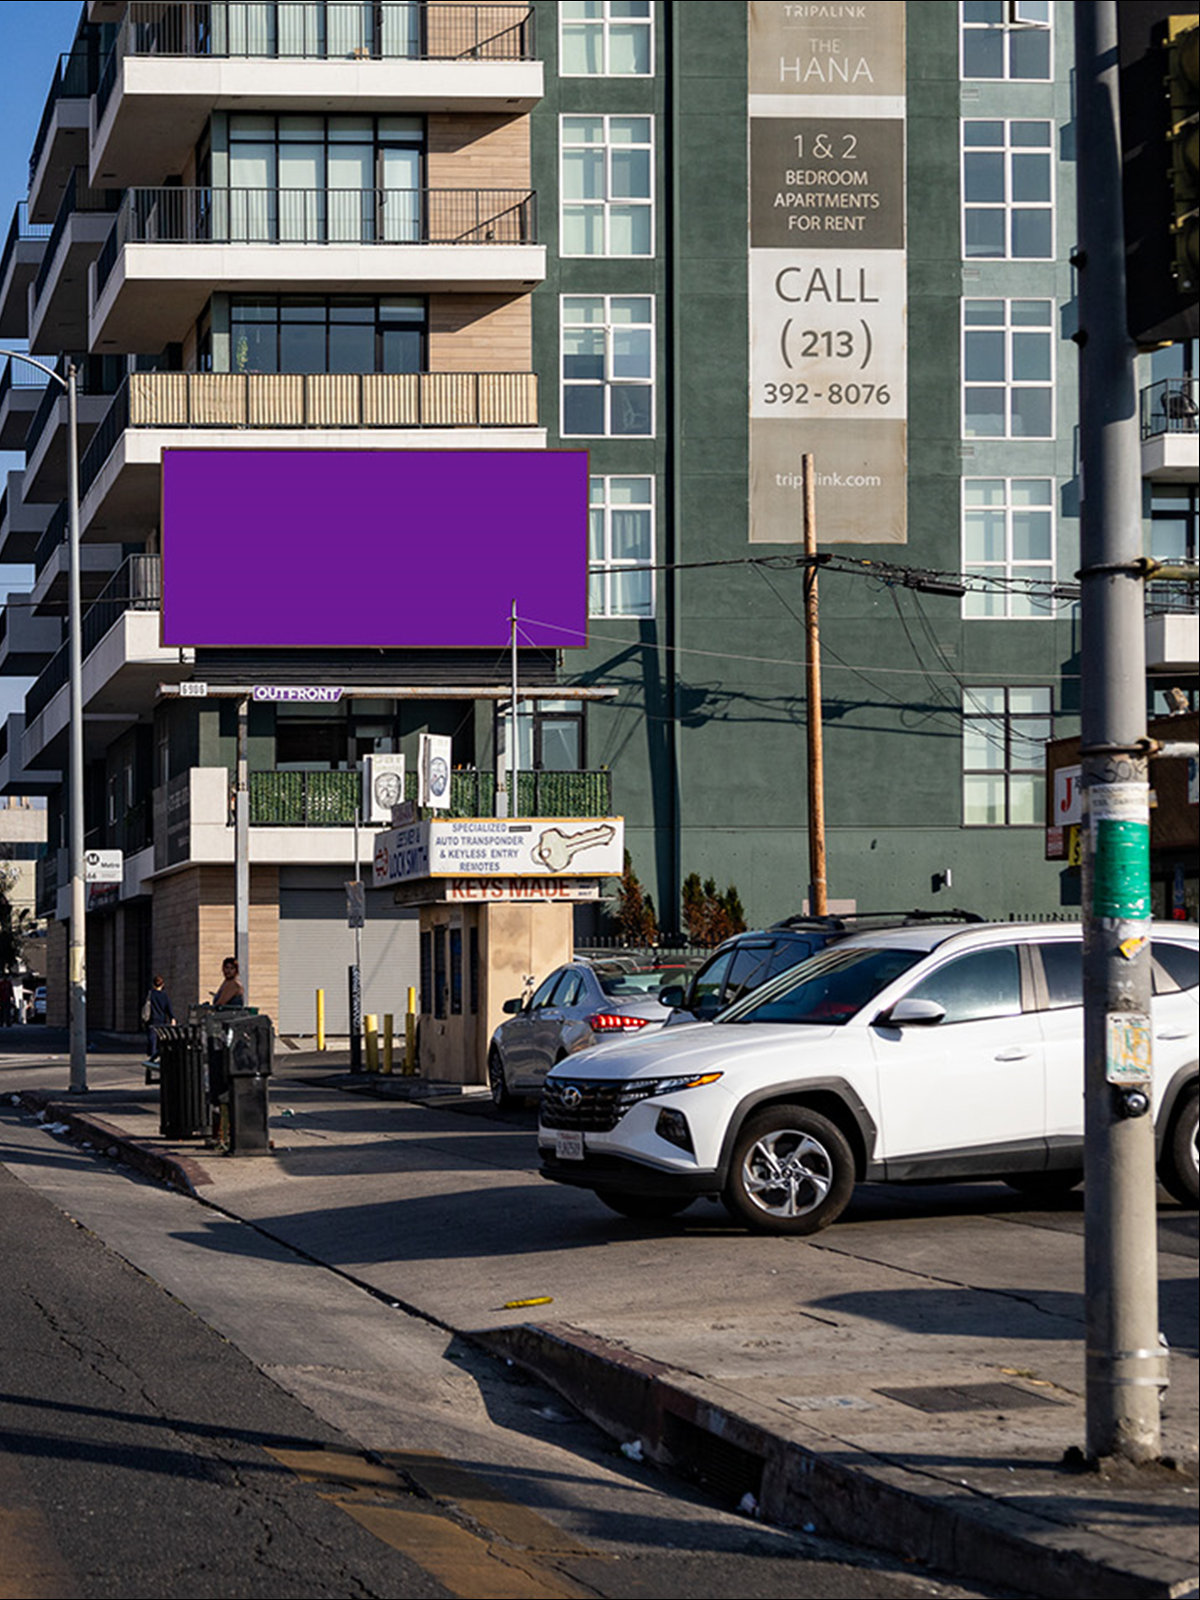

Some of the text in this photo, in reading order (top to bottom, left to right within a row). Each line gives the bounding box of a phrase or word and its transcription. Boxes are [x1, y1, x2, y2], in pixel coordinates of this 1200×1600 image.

[784, 5, 866, 18] TRIPALINK
[809, 38, 841, 54] THE
[780, 56, 874, 83] HANA
[794, 133, 858, 159] 1 & 2
[785, 170, 869, 186] BEDROOM
[773, 192, 880, 209] APARTMENTS
[788, 215, 866, 231] FOR RENT
[775, 266, 879, 303] CALL
[776, 472, 881, 489] triplink.com
[255, 686, 340, 700] OUTFRONT
[452, 823, 507, 833] SPECIALIZED
[435, 836, 524, 846] AUTO TRANSPONDER
[439, 849, 519, 859] & KEYLESS ENTRY
[459, 862, 500, 871] REMOTES
[452, 878, 503, 898] KEYS
[509, 878, 570, 898] MADE
